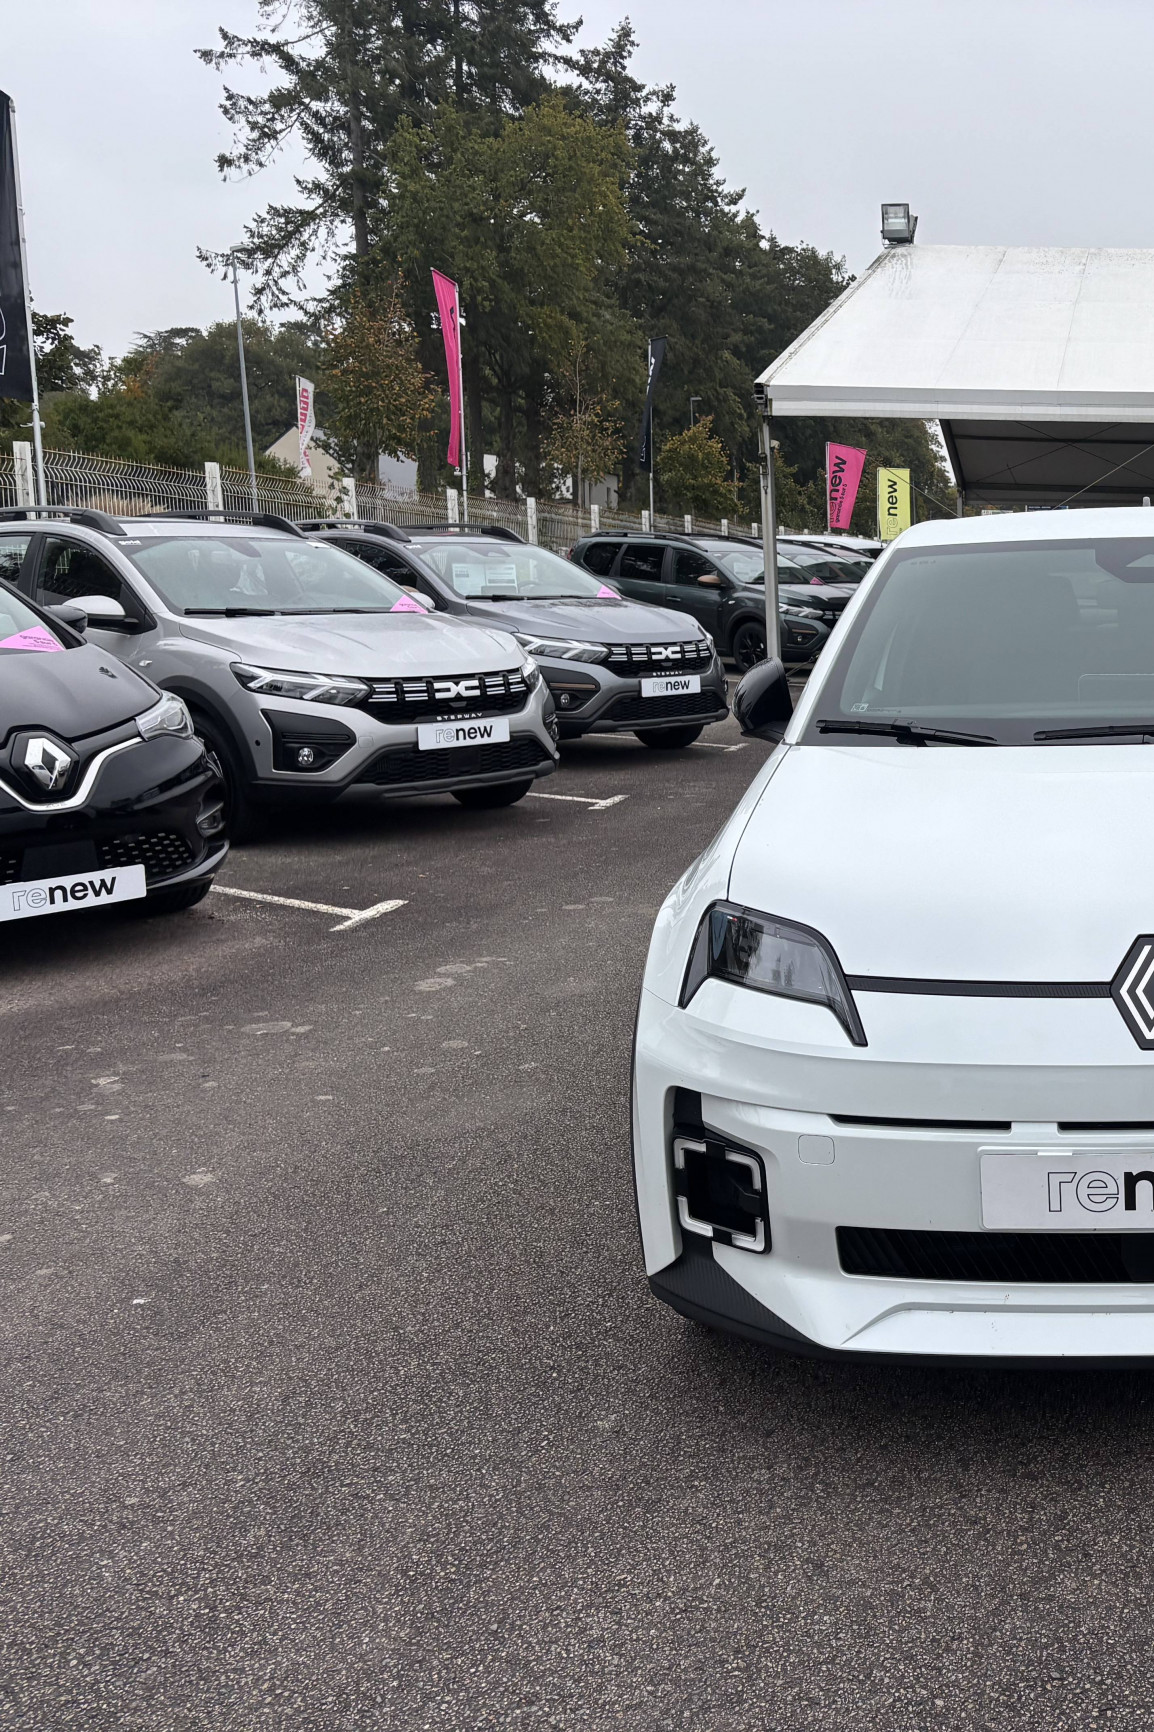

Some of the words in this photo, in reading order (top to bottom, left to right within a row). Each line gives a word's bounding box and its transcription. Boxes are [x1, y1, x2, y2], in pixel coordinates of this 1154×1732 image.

[887, 479, 898, 536] renew
[652, 679, 691, 693] renew
[436, 712, 483, 721] STEPWAY
[435, 724, 493, 743] renew
[11, 876, 117, 912] renew
